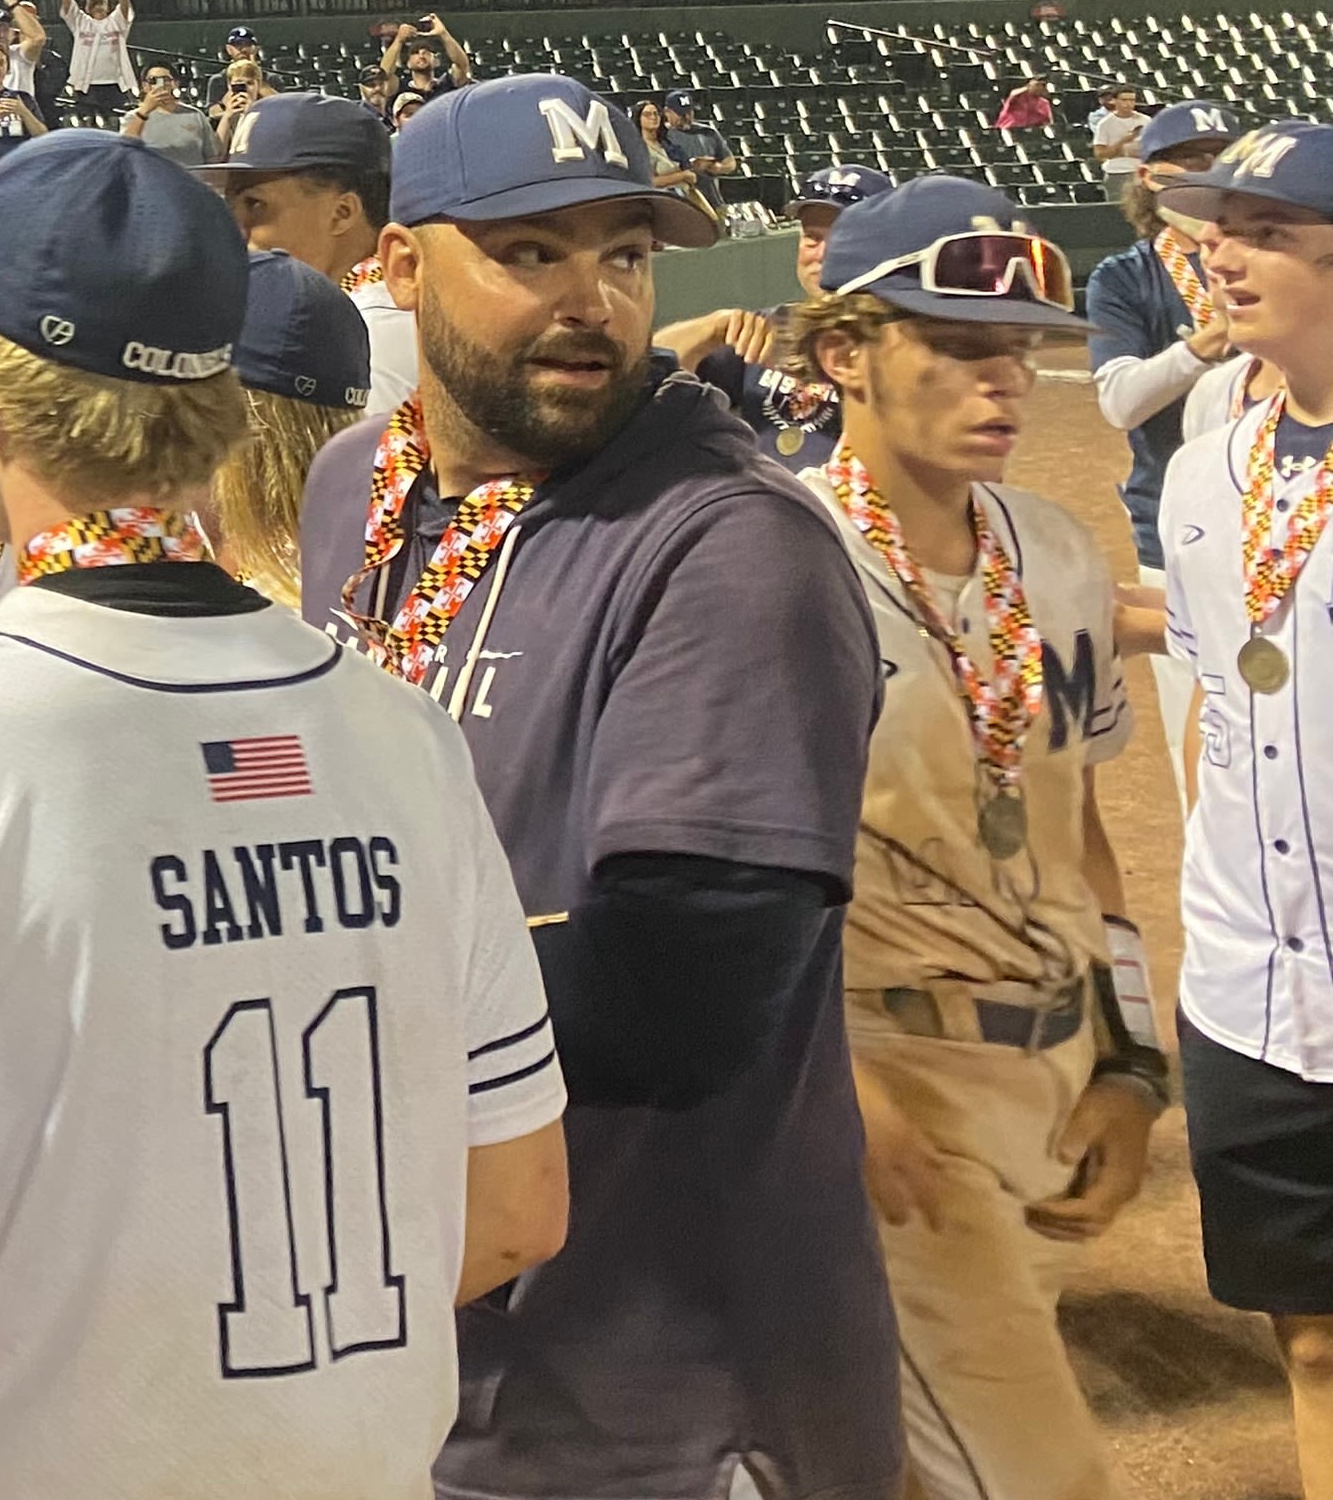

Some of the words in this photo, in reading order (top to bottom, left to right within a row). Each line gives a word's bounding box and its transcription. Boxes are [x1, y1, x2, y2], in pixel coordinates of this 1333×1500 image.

[538, 98, 630, 170] M
[1190, 107, 1230, 133] M
[1039, 629, 1096, 750] M
[151, 835, 402, 951] SANTOS
[203, 985, 407, 1380] 11
